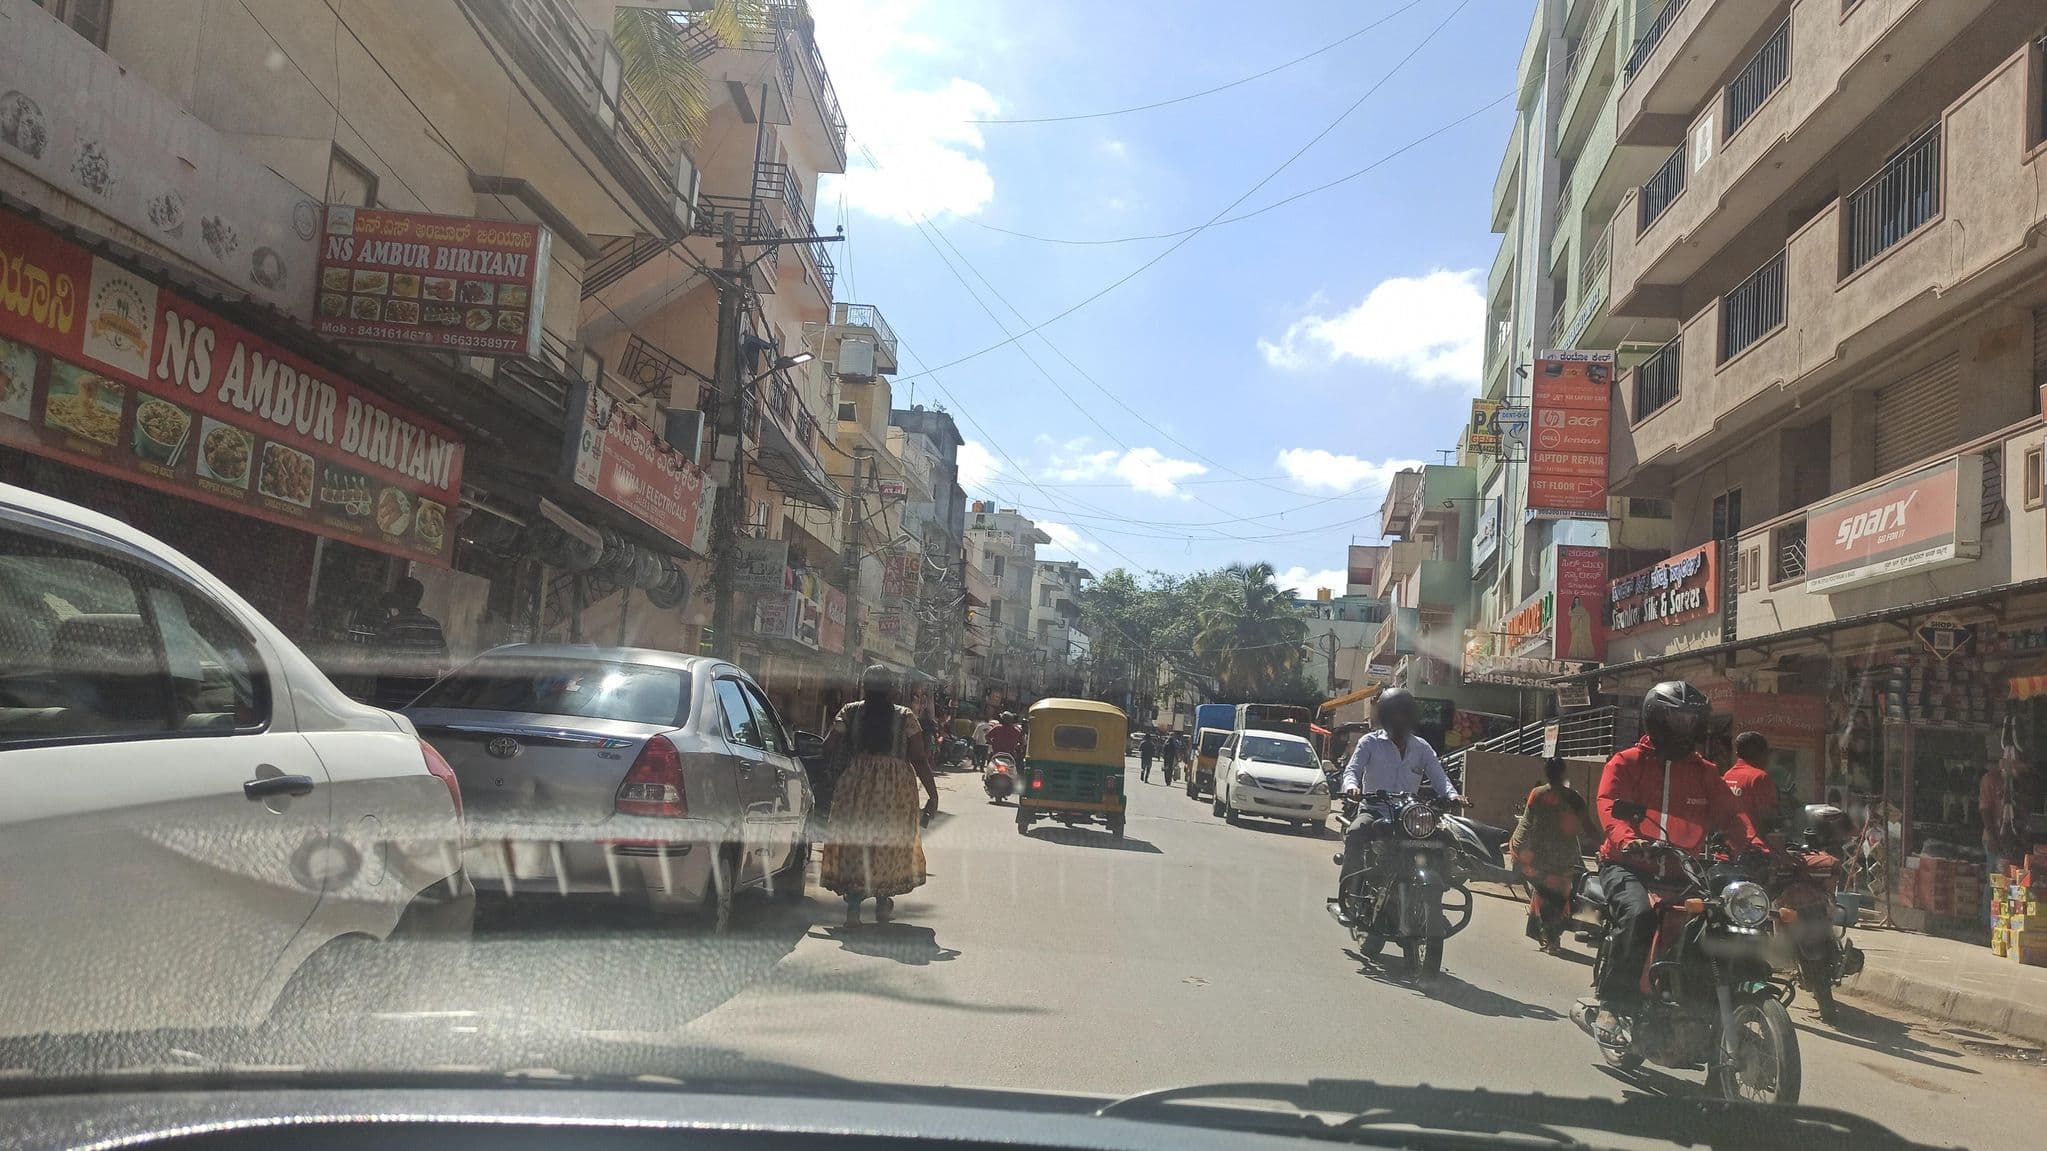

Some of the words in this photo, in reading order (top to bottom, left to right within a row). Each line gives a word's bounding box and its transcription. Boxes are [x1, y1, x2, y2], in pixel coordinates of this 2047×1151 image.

[326, 236, 355, 262] NS
[357, 240, 430, 270] AMBUR
[434, 246, 528, 278] BIRIYANI
[321, 322, 348, 335] Mob
[443, 334, 519, 350] 9663358977
[155, 309, 217, 394] NS
[217, 343, 336, 445] AMBUR
[340, 395, 458, 491] BIRIYANI
[1568, 416, 1603, 427] acer
[1542, 434, 1559, 442] DELL
[1564, 436, 1601, 445] lenovo
[1533, 453, 1569, 465] LAPTOP
[1572, 455, 1605, 465] REPAIR
[1532, 480, 1547, 489] 1ST
[1550, 481, 1575, 491] FLOOR
[646, 485, 687, 522] ELECTRICALS
[1835, 489, 1918, 550] sparx
[1643, 596, 1659, 623] Silk
[1661, 592, 1668, 618] &
[1669, 587, 1701, 615] Sarees
